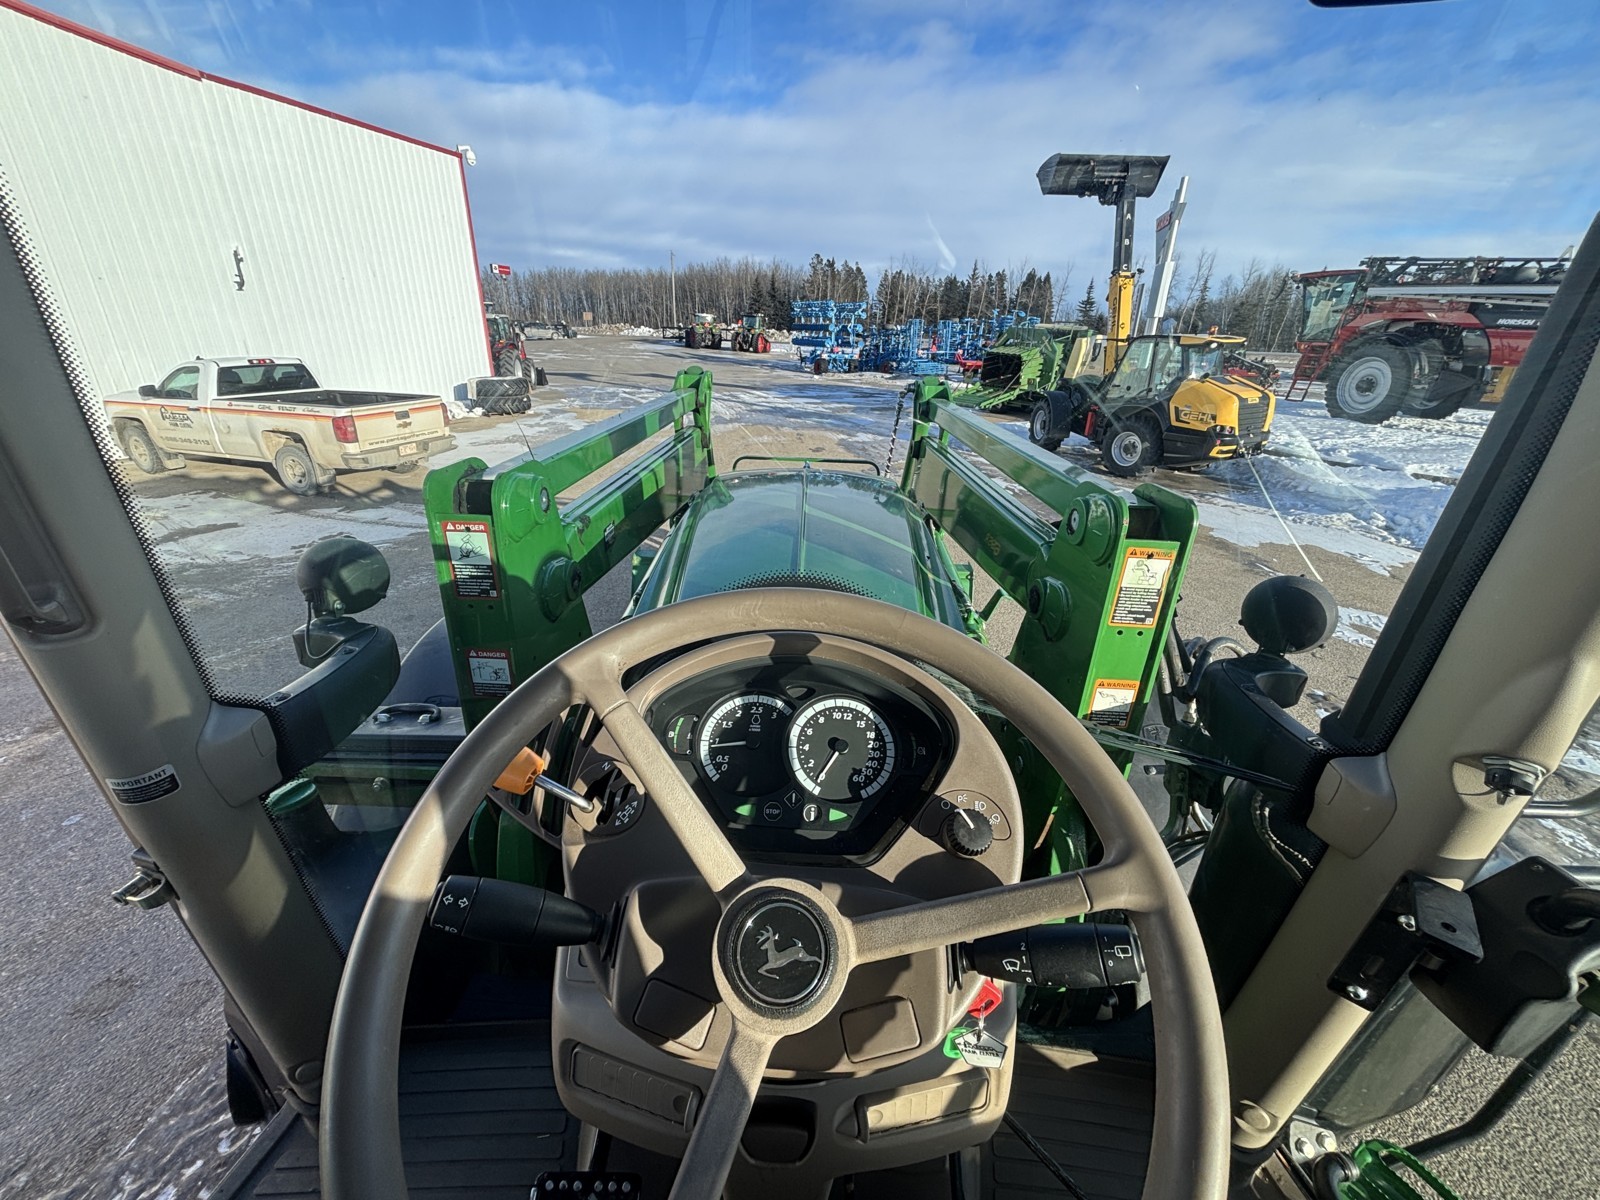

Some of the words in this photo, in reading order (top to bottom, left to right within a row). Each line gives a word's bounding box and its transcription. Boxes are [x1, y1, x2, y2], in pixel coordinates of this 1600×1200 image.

[1124, 238, 1130, 246] B
[1496, 318, 1536, 326] HORSCH
[1180, 410, 1215, 423] GEHL
[750, 706, 763, 714] 2.5
[722, 721, 733, 729] 1.5
[856, 720, 866, 728] 15
[866, 731, 876, 739] 18
[803, 743, 810, 751] 4
[716, 755, 729, 763] 0.5
[807, 759, 814, 767] 2
[865, 760, 878, 768] 40
[861, 768, 873, 776] 50
[110, 768, 167, 788] IMPORTANT
[852, 774, 865, 782] 60
[1020, 942, 1026, 950] 2
[1022, 955, 1026, 964] 1
[1108, 959, 1114, 967] 0
